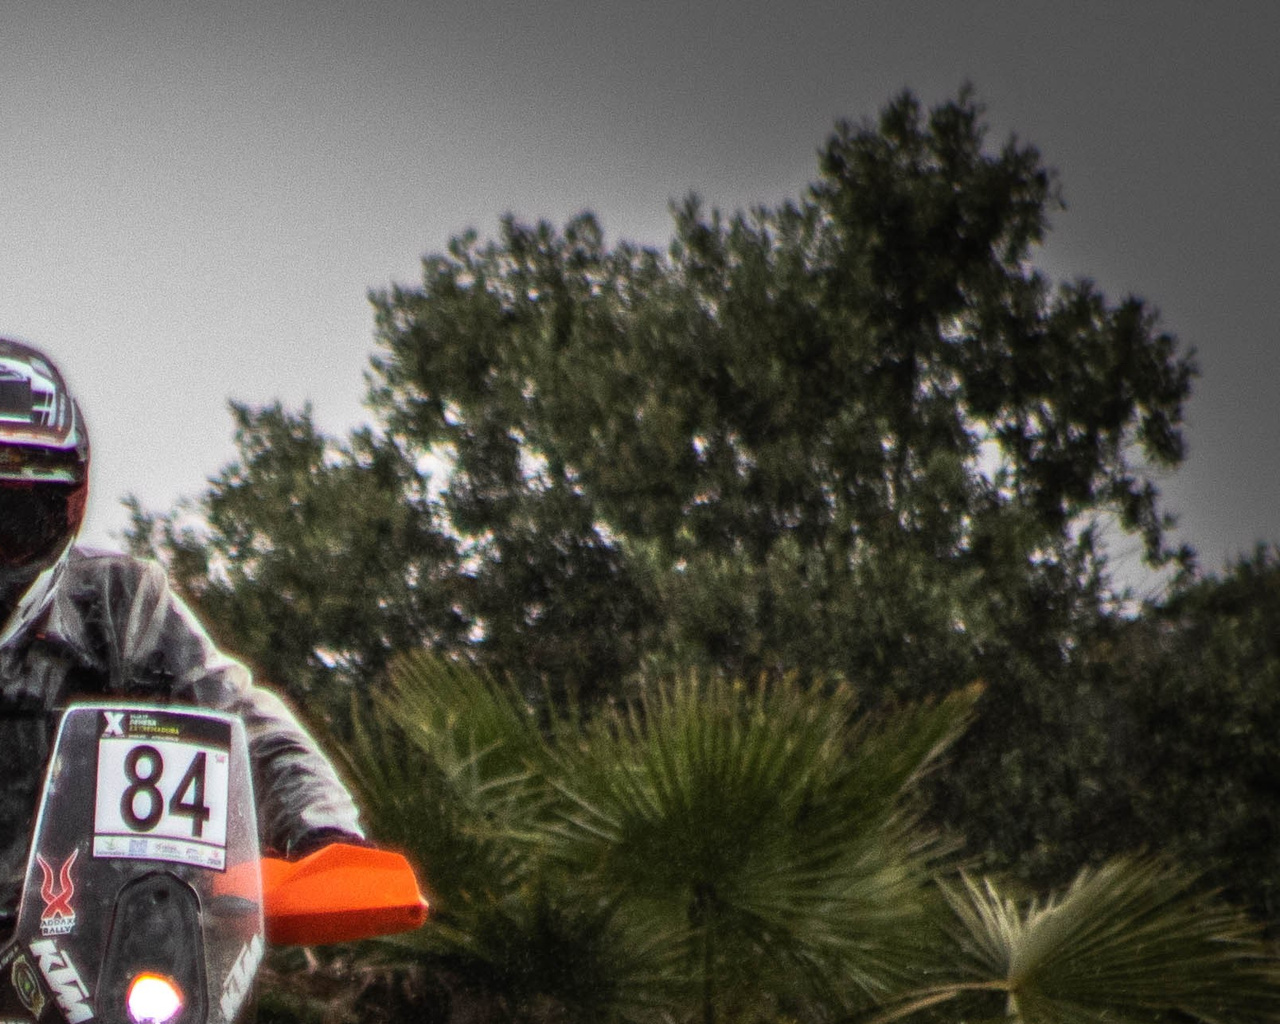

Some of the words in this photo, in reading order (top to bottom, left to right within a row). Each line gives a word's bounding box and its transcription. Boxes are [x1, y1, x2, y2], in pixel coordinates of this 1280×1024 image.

[120, 745, 210, 838] 84
[43, 926, 71, 935] RALLY
[29, 940, 94, 1024] KTM
